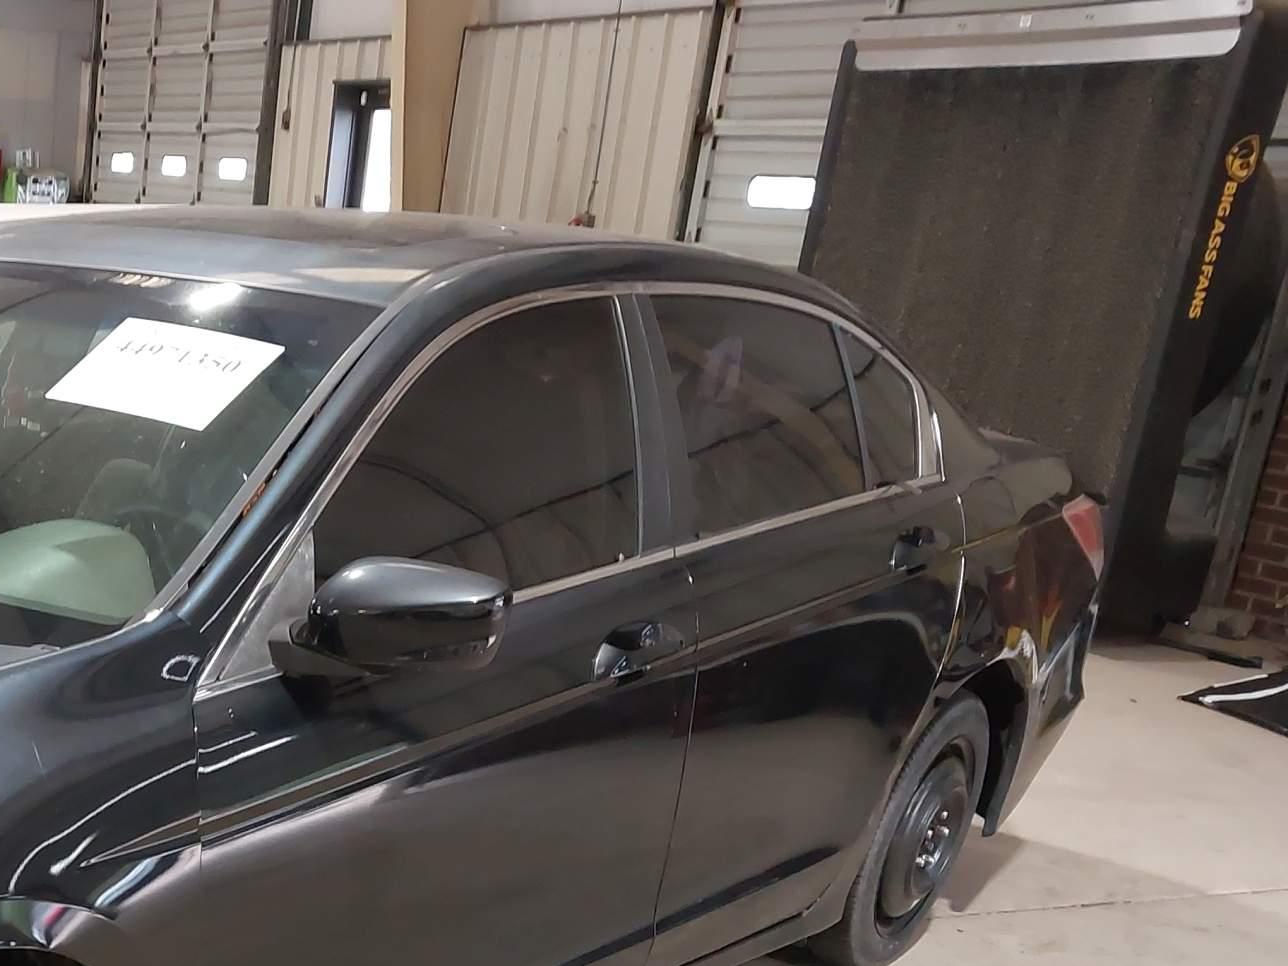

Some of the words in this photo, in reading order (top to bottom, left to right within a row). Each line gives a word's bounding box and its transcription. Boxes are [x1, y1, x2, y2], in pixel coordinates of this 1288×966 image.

[1216, 180, 1239, 217] BIG
[1203, 217, 1227, 263] ASS
[1188, 263, 1215, 319] FANS
